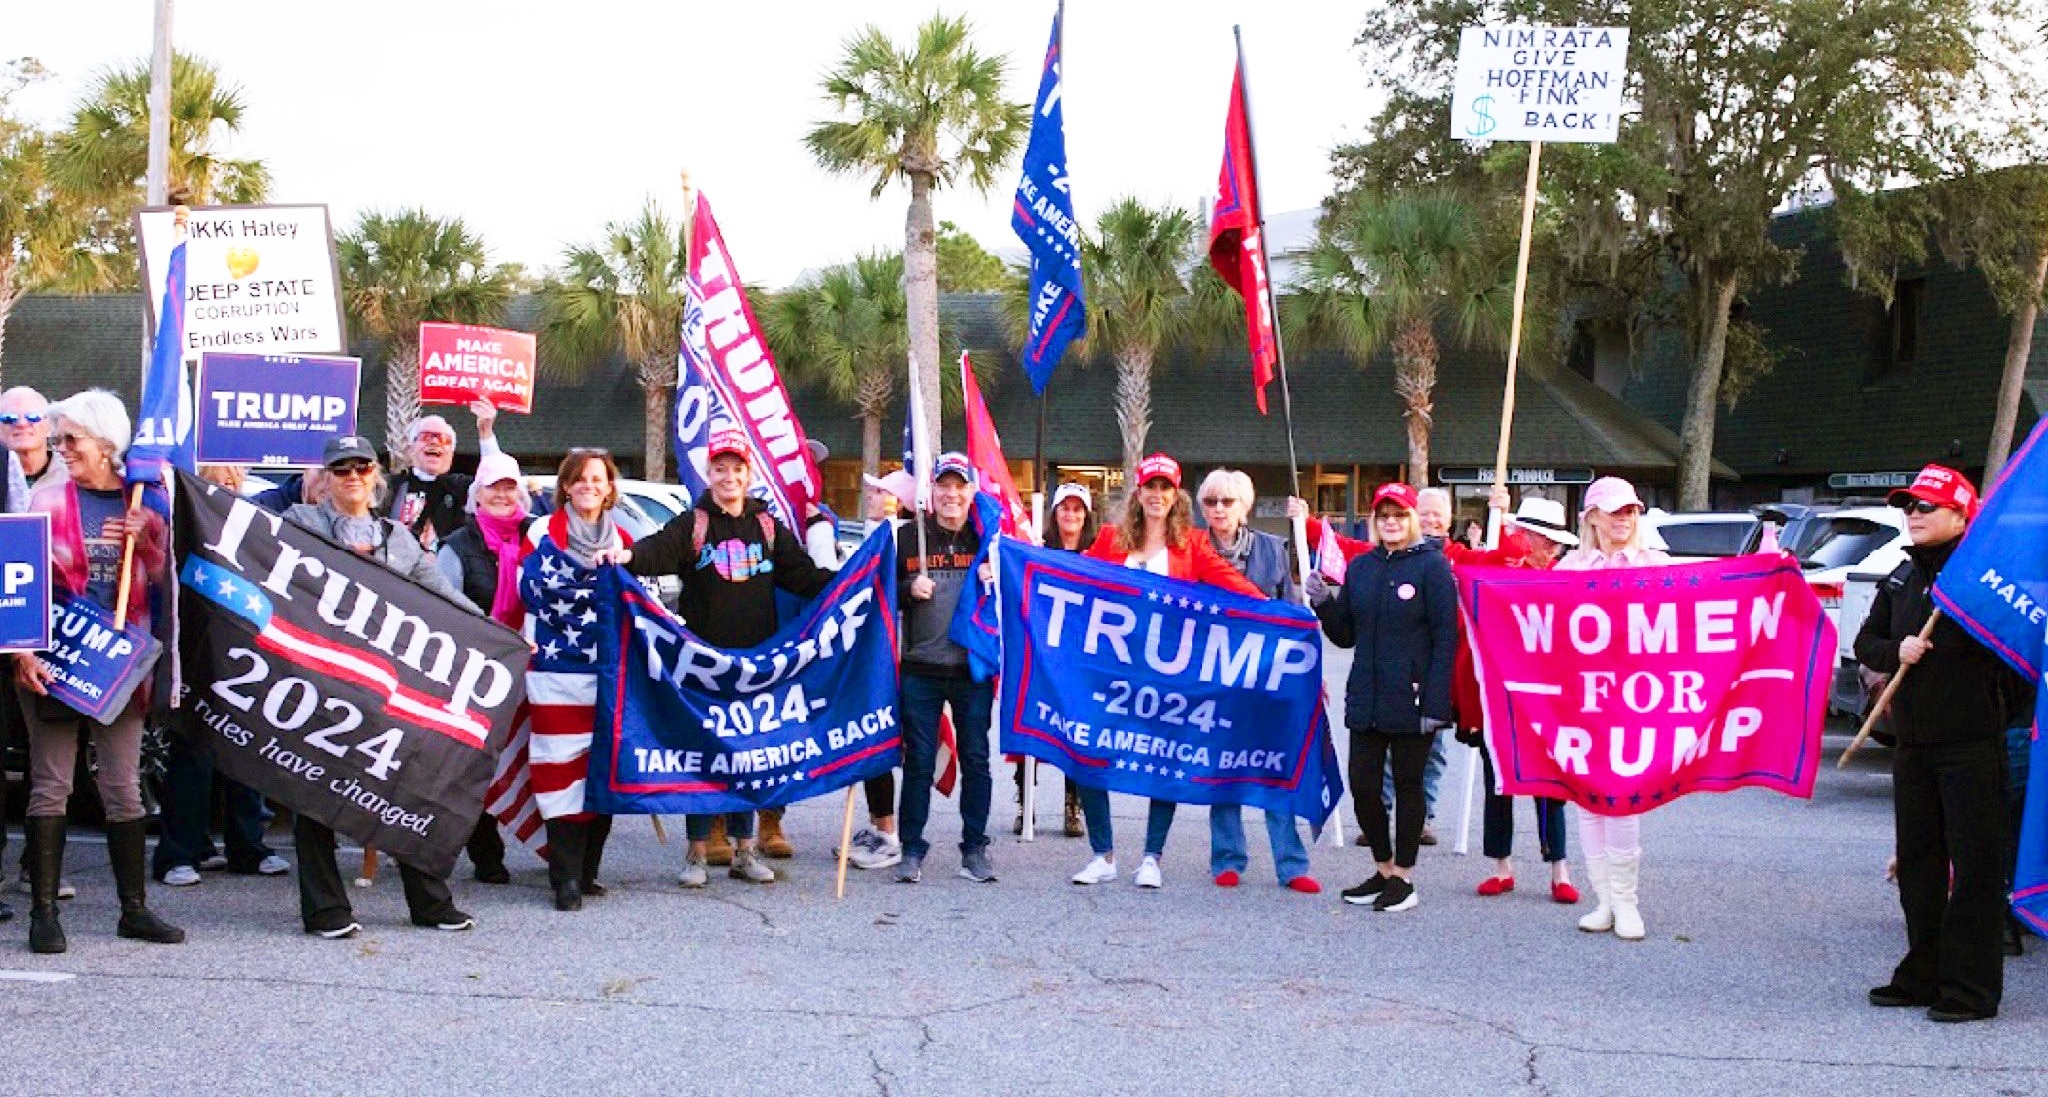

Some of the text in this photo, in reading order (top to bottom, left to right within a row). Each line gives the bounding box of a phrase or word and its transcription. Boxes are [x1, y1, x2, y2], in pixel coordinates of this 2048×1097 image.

[1513, 50, 1576, 66] GIVE
[1466, 93, 1496, 136] $
[185, 219, 298, 239] iKKi Haley
[194, 301, 299, 320] CORRUPTION
[248, 279, 315, 298] STATE
[188, 325, 318, 349] Endless Wars
[456, 337, 503, 355] MAKE
[424, 374, 528, 396] GREAT AGAIN
[425, 351, 528, 380] AMERICA
[211, 391, 347, 421] TRUMP
[203, 486, 513, 718] Trump
[1510, 591, 1786, 655] WOMEN
[1979, 568, 2048, 625] MAKE
[52, 603, 133, 660] RUMP
[1037, 583, 1319, 691] TRUMP
[211, 647, 404, 781] 2024
[702, 683, 827, 738] -2024-
[1092, 680, 1233, 734] -2024-
[1579, 670, 1707, 714] FOR
[634, 705, 896, 775] TAKE AMERICA BACK
[1037, 701, 1286, 772] TAKE AMERICA BACK
[1530, 706, 1763, 777] RUMP
[195, 698, 435, 838] rules have changed.
